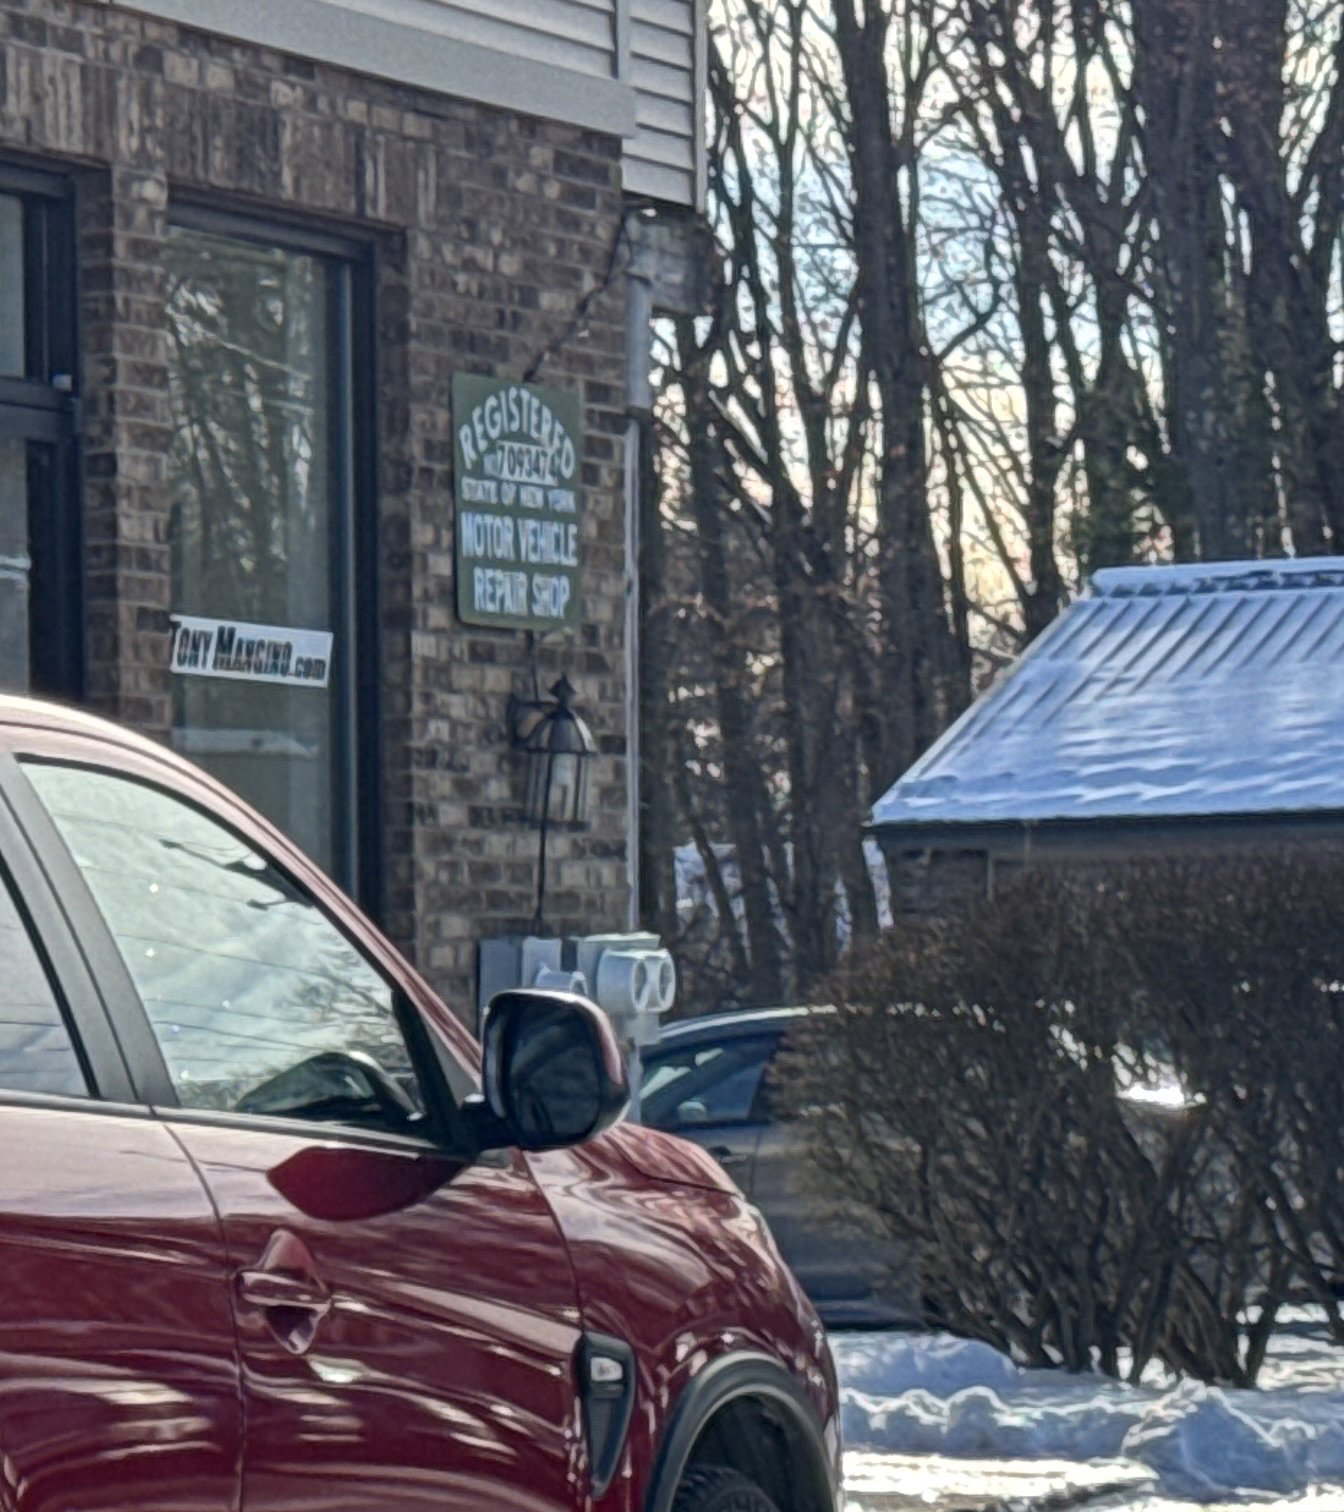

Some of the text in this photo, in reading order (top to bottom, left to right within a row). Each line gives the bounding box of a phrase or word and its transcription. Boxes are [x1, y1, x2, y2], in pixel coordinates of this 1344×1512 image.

[459, 386, 575, 480] REGISTERED
[461, 511, 578, 567] MOTOR VEHICLE
[473, 566, 571, 618] REPAIR SHOP
